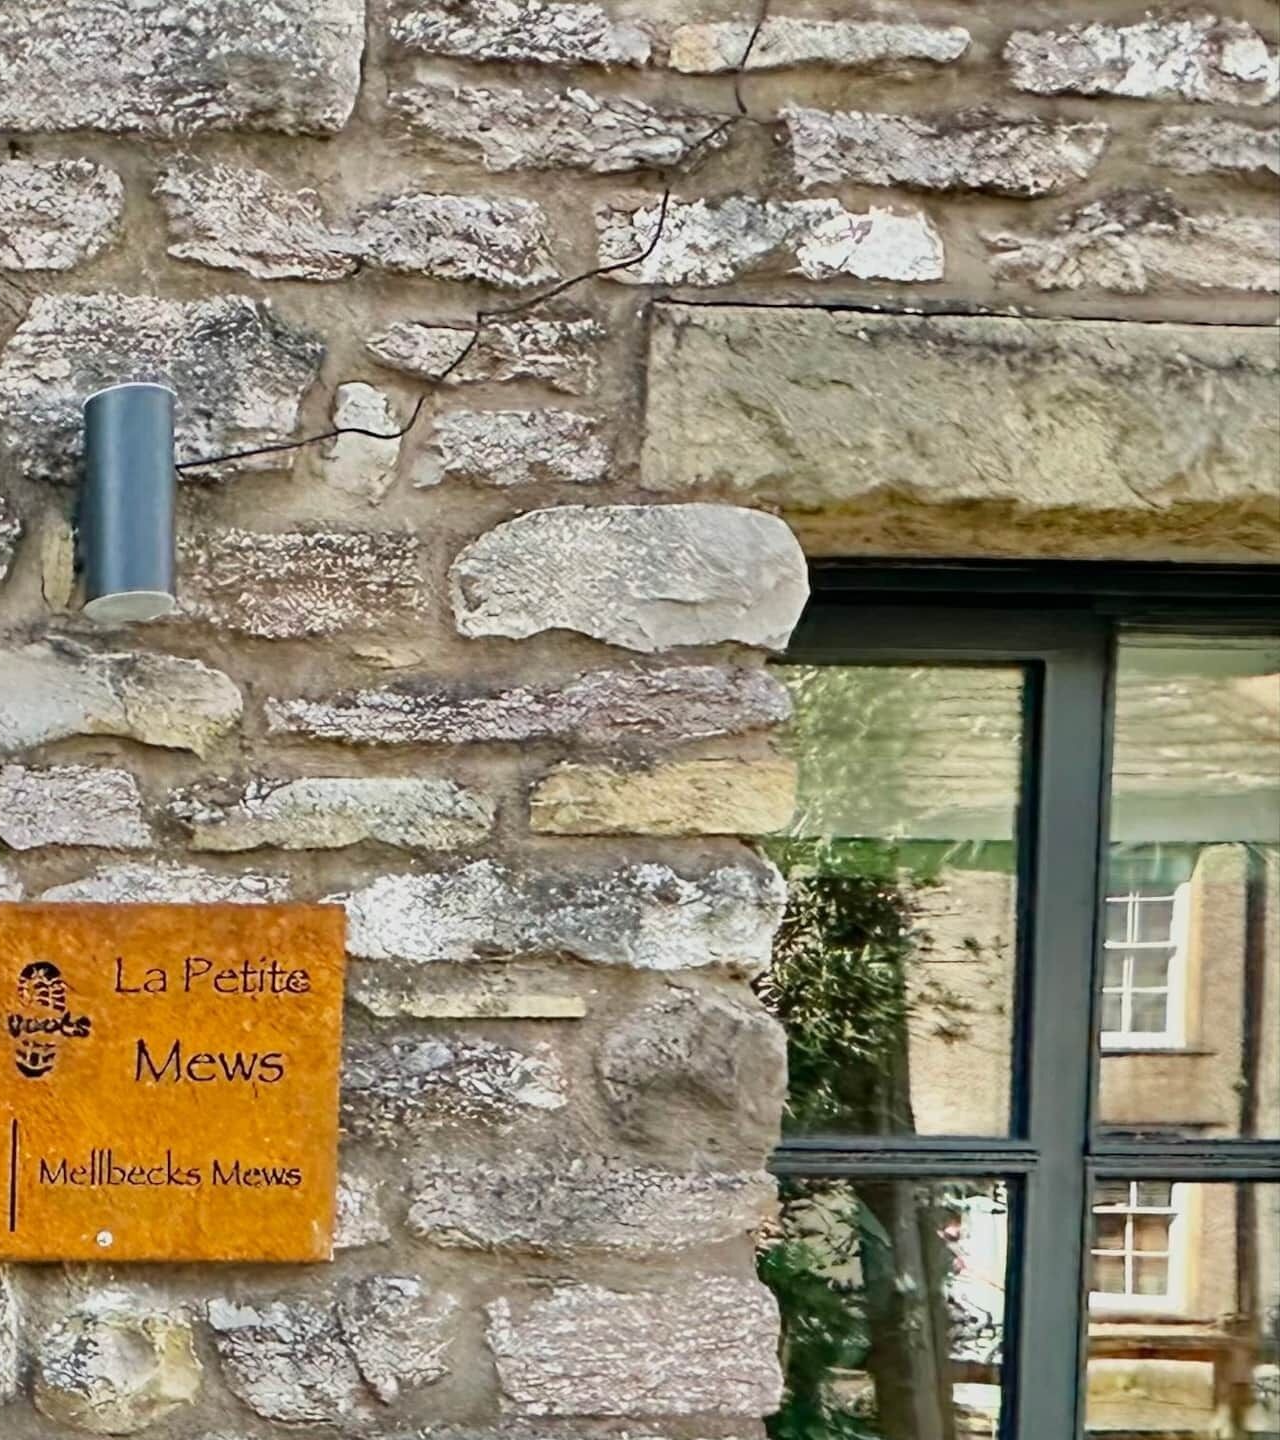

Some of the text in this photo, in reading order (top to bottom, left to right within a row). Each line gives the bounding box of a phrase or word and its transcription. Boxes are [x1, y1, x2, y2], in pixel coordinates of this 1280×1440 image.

[114, 956, 312, 994] La Petite
[135, 1038, 285, 1082] Mews
[40, 1148, 201, 1187] Mellbecks
[211, 1158, 303, 1189] Mews
